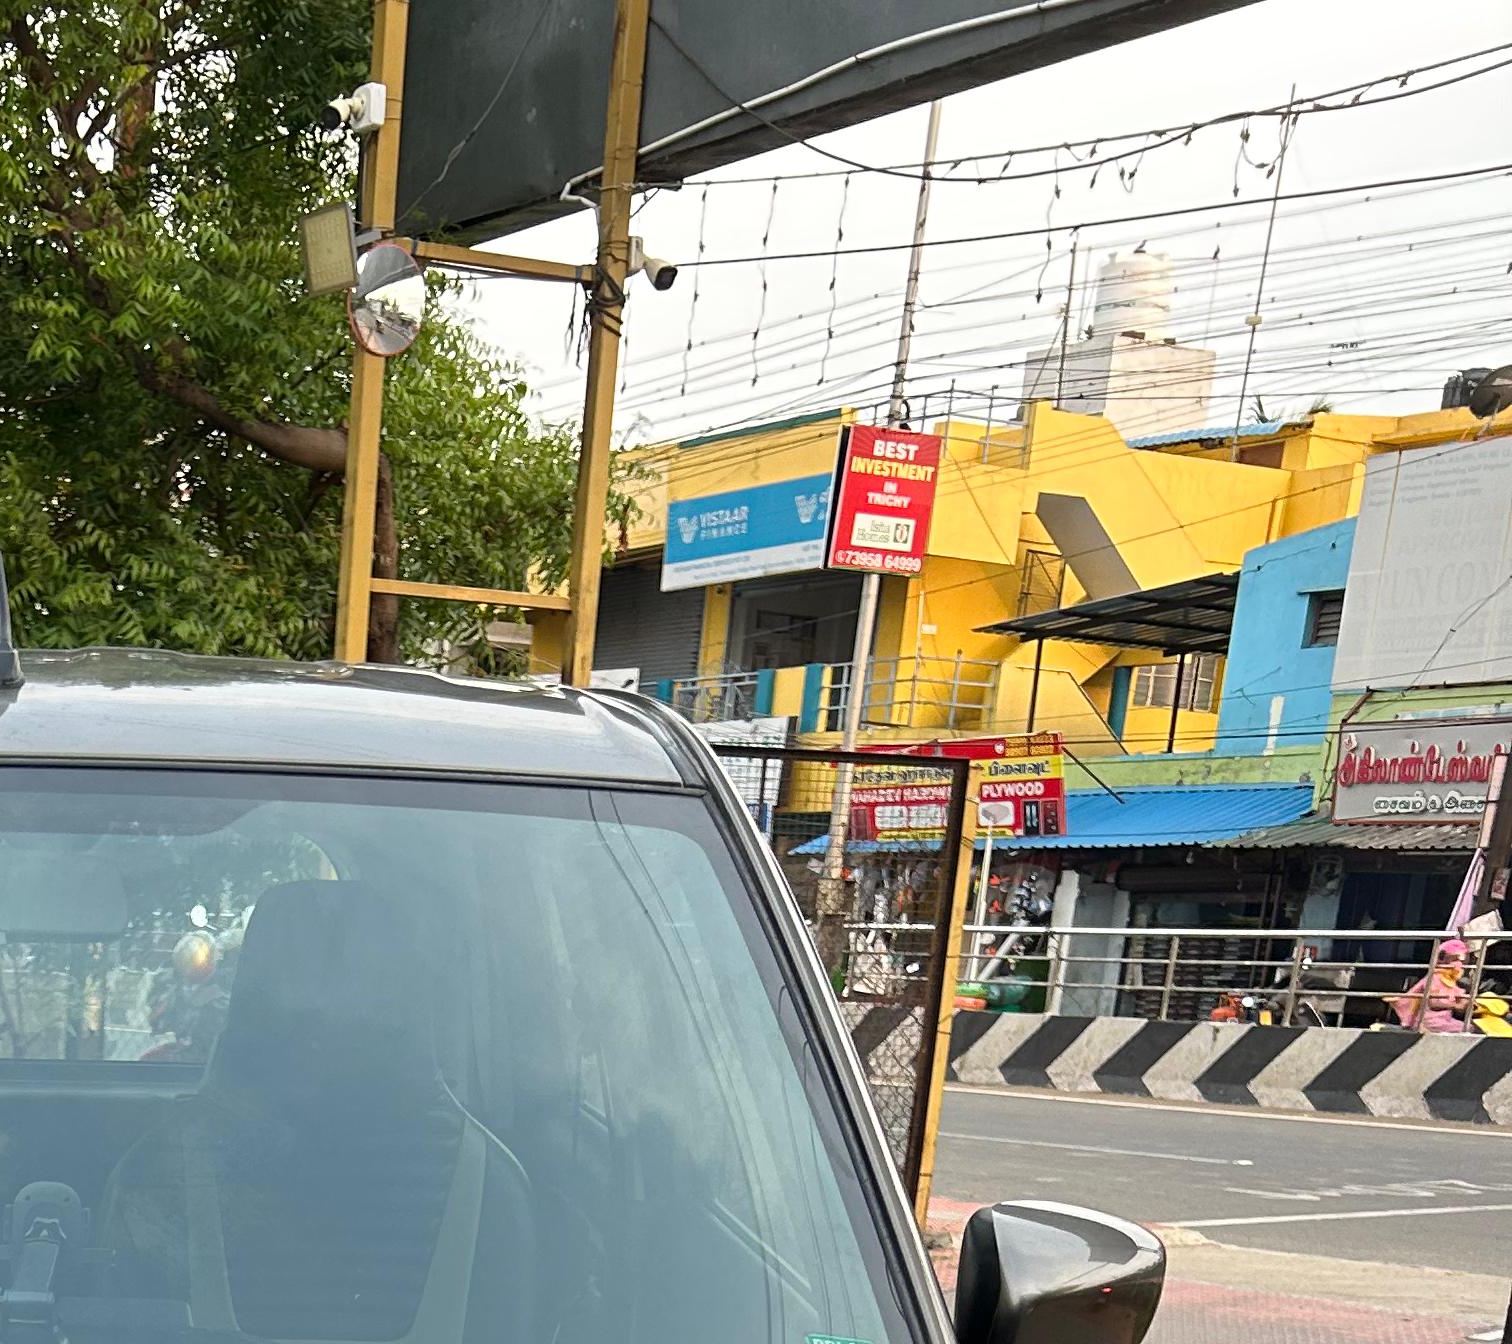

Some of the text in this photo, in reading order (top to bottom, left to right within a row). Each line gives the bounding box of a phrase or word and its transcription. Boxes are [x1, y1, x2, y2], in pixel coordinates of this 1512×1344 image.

[873, 439, 919, 461] BEST
[850, 456, 935, 482] INVESTMENT
[883, 481, 898, 494] IN
[867, 491, 911, 508] TRICHY
[699, 506, 749, 528] VISTAAR
[982, 782, 1045, 798] PLYWOOD
